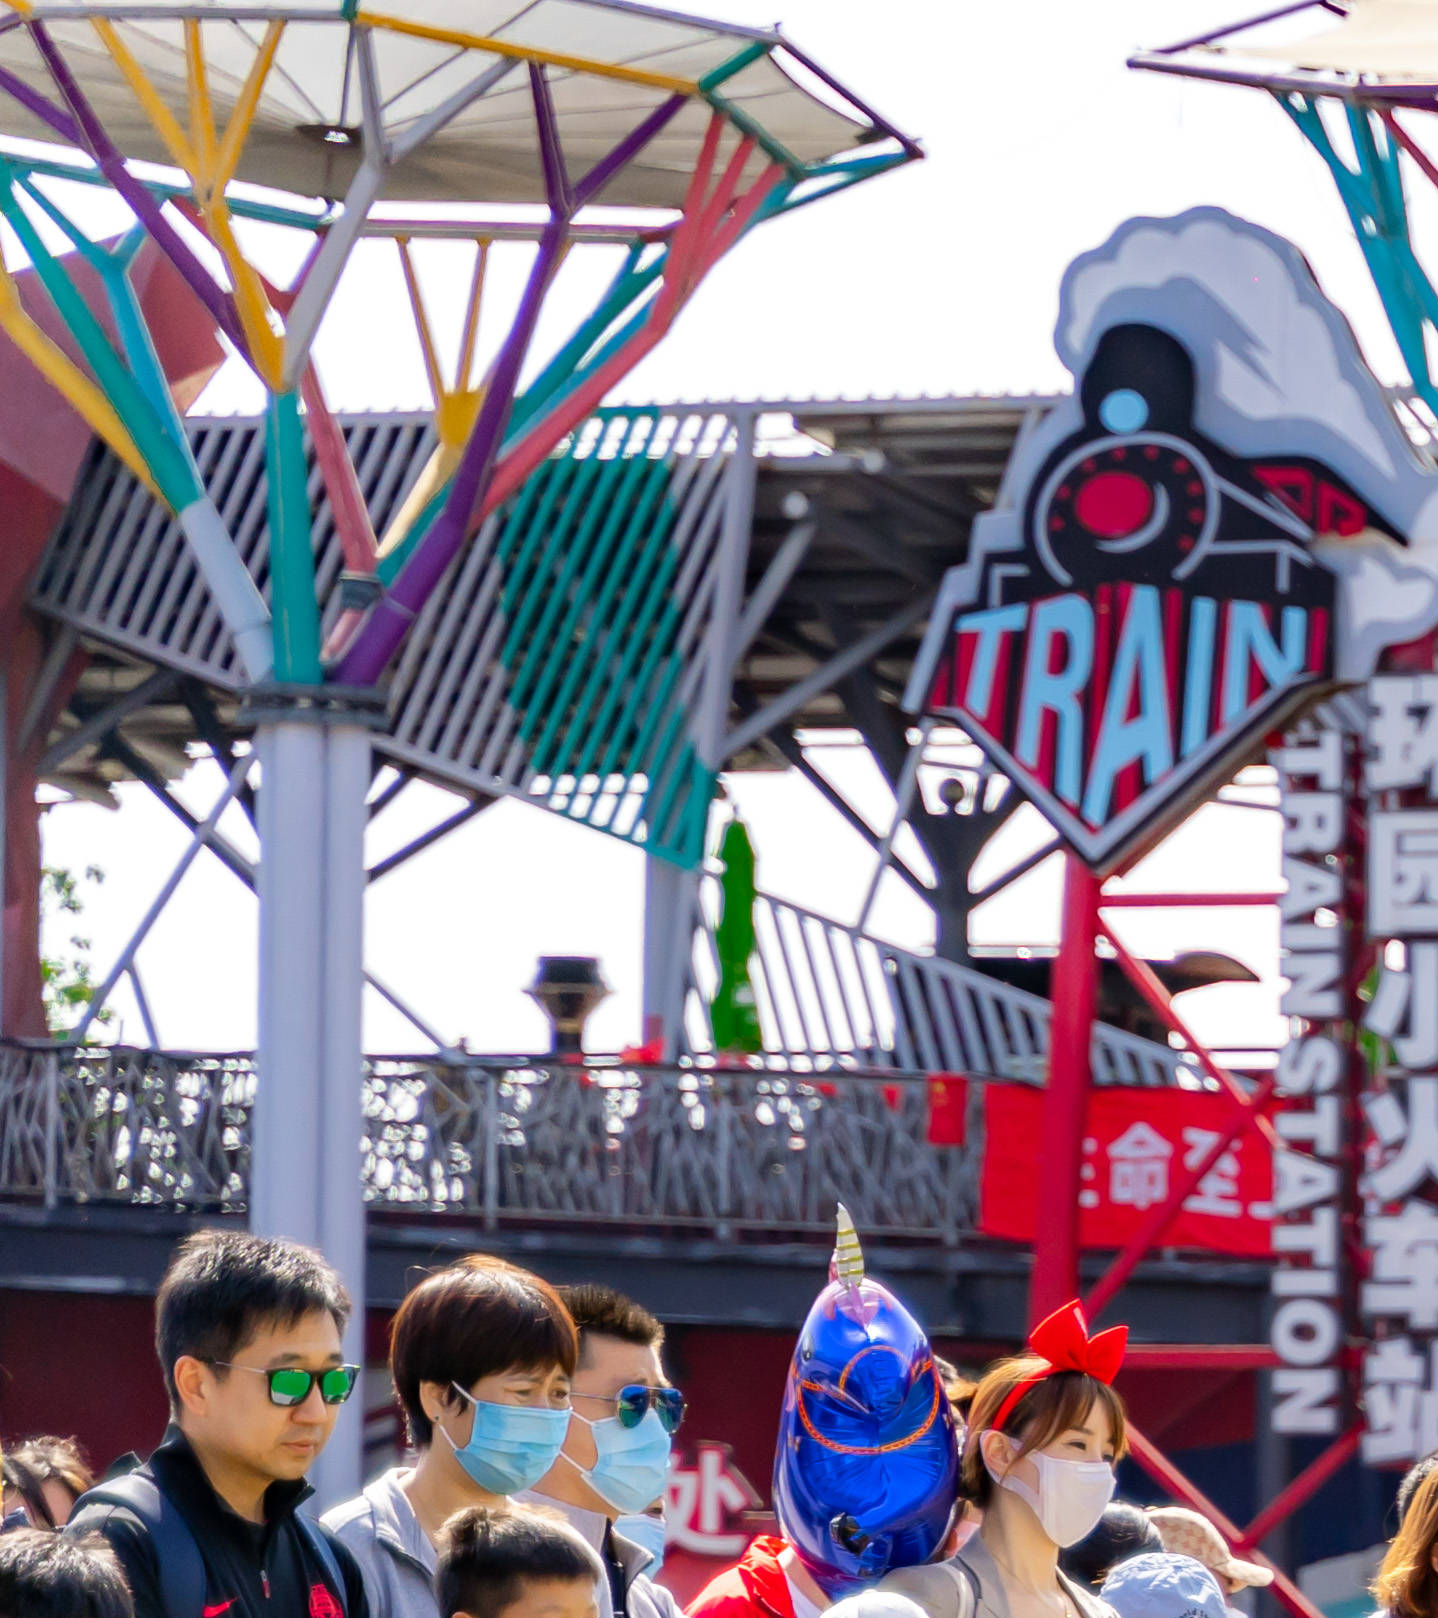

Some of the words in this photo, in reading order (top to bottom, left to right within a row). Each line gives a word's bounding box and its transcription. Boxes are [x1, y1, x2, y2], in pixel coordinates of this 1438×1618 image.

[957, 586, 1307, 826] TRAIN
[1282, 730, 1345, 1018] TRAIN
[1271, 1037, 1342, 1434] STATION
